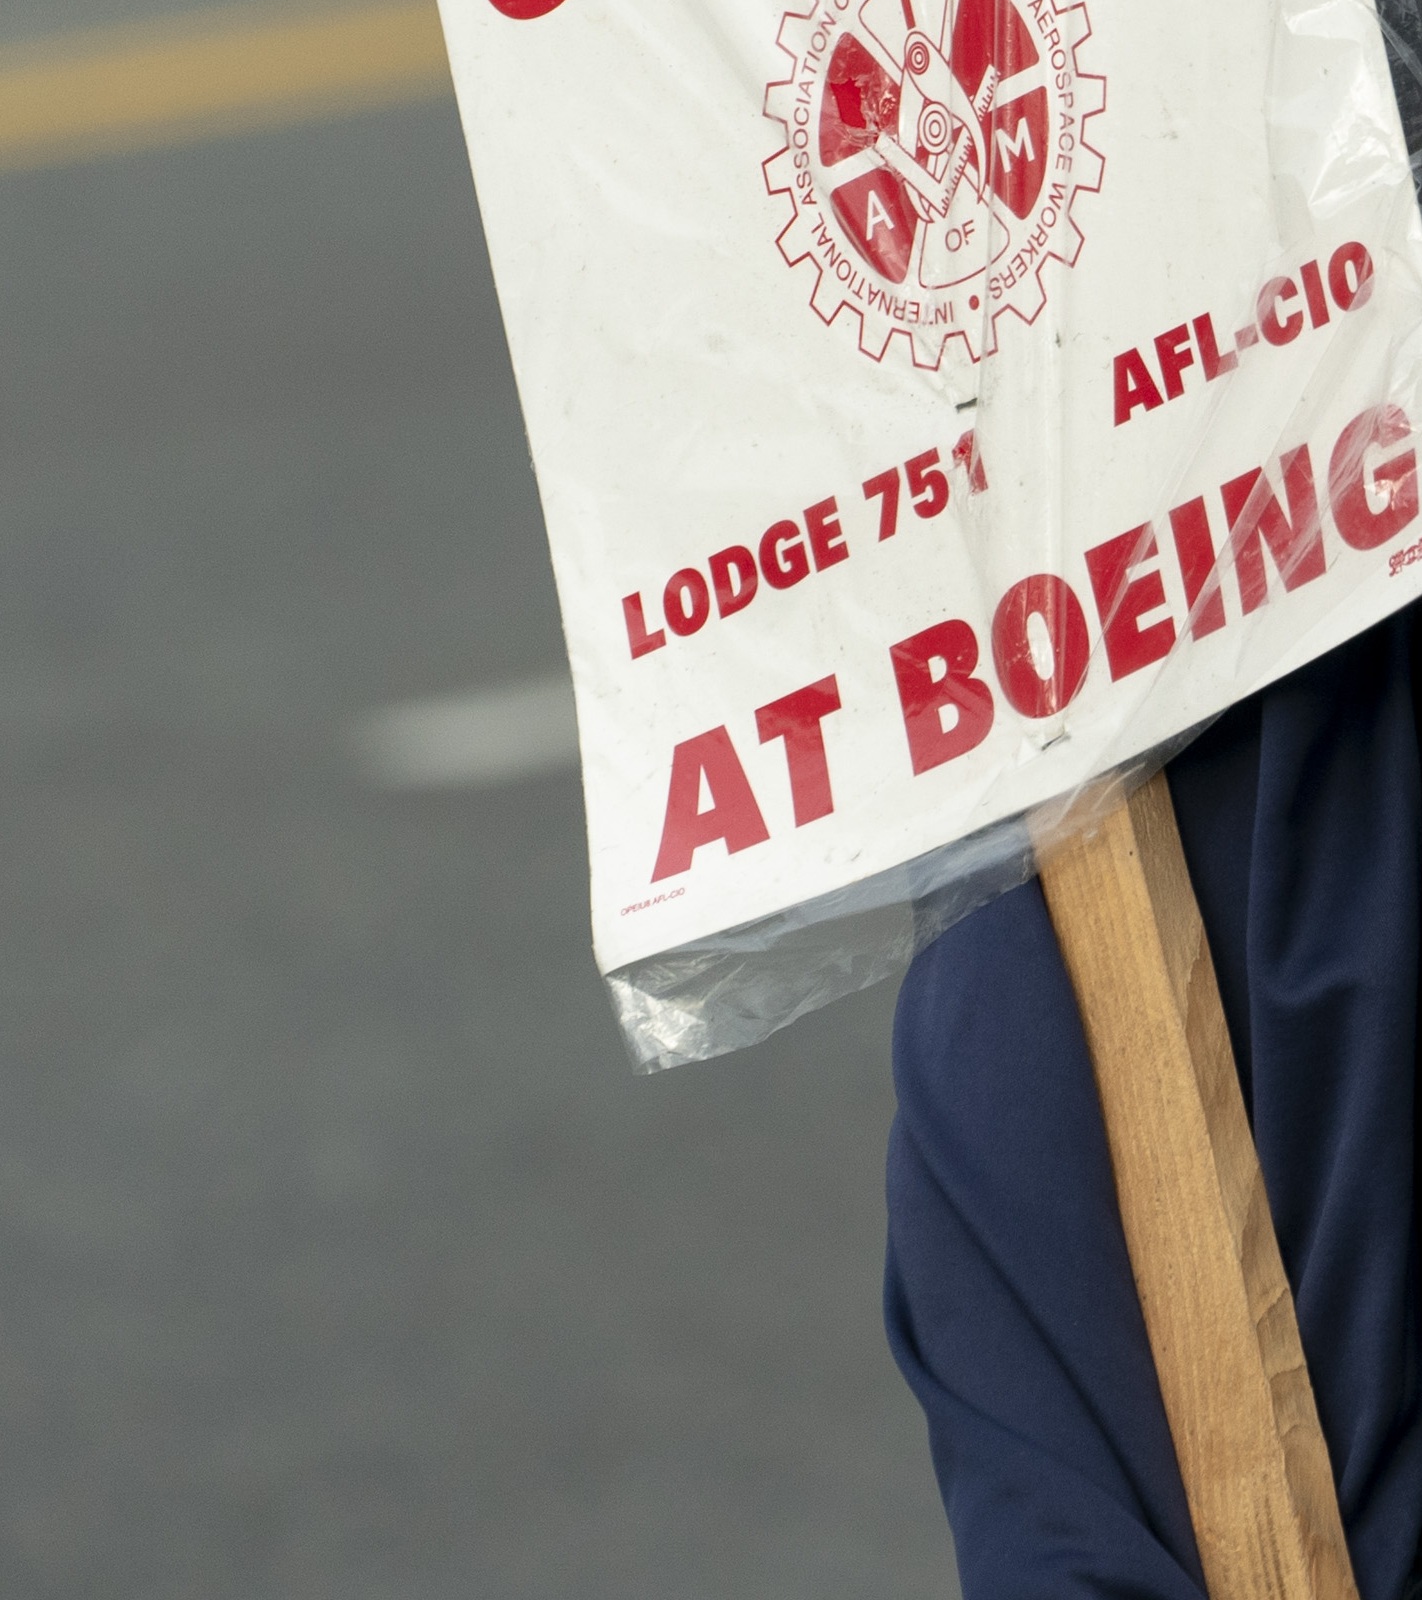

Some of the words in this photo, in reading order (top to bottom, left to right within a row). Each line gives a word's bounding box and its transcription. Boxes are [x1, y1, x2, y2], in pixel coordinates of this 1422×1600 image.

[793, 15, 838, 206] ASSOCIATION
[995, 117, 1035, 172] M
[811, 211, 955, 325] INTERNATIONAL
[865, 190, 894, 240] A
[945, 220, 975, 253] OF
[989, 182, 1067, 300] WORKERS
[1112, 240, 1375, 427] AFL-CIO
[622, 495, 849, 660] LODGE
[861, 428, 988, 542] 751
[650, 673, 842, 884] AT
[888, 403, 1421, 777] BOEING
